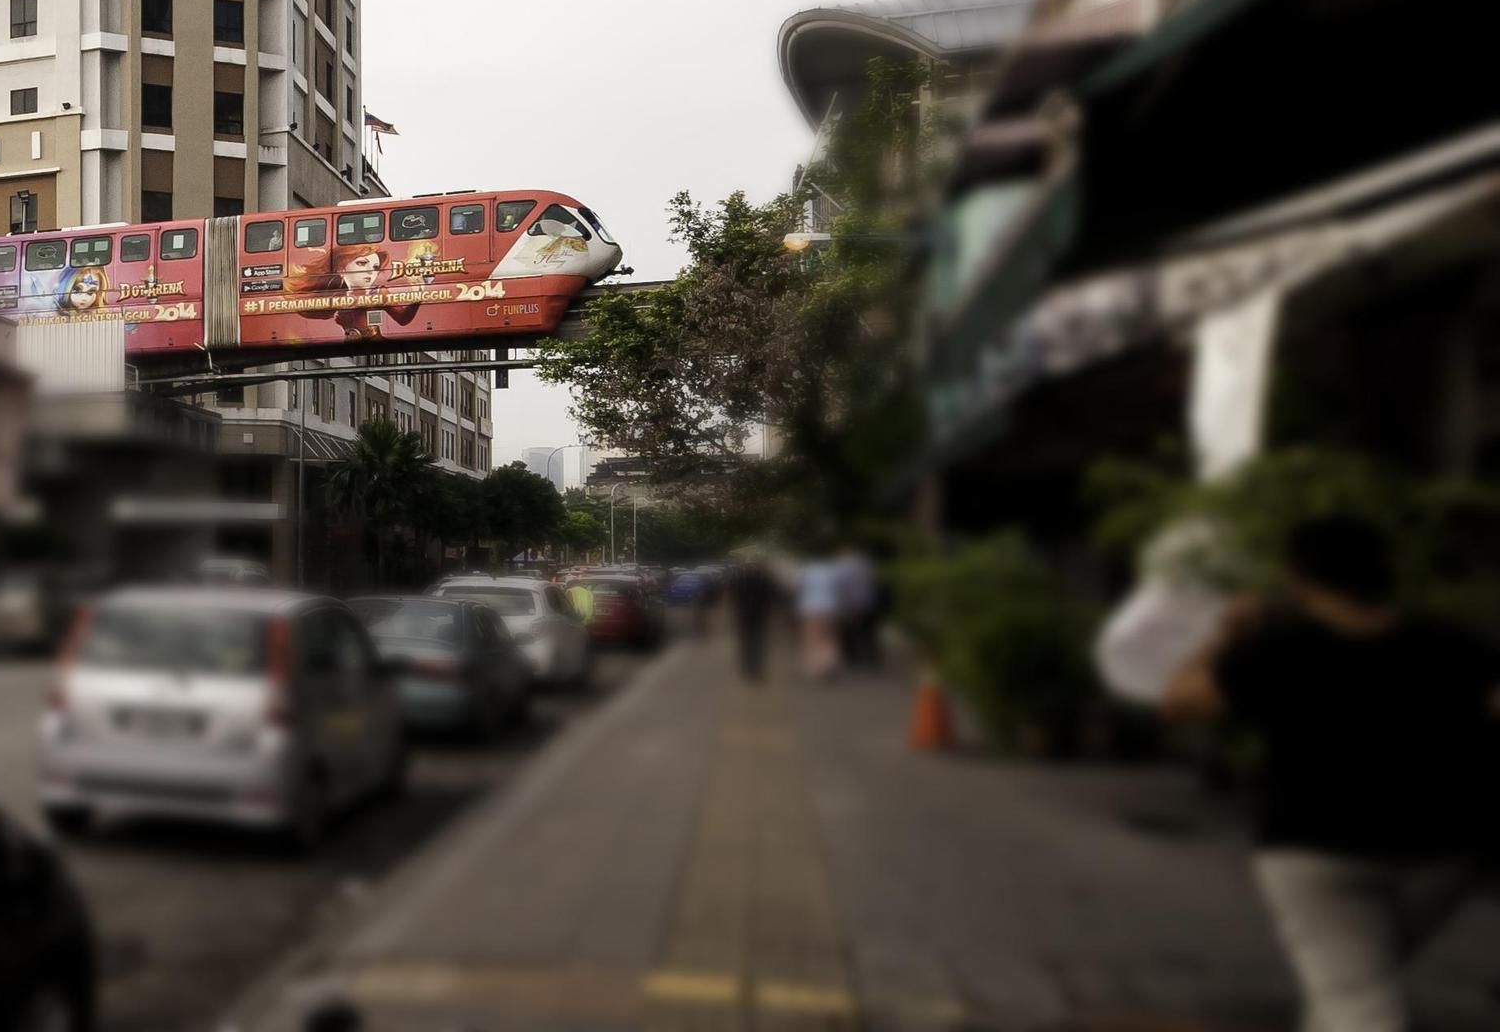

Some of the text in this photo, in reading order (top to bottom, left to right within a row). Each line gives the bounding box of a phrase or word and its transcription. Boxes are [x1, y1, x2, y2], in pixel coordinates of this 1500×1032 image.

[424, 257, 467, 275] ARENA
[147, 280, 188, 297] ARENA
[244, 280, 506, 313] #1 PERMAINAN KAD AKSI TERUNGGUL 2014
[153, 303, 197, 322] 2014
[503, 303, 540, 315] FUNPLUS
